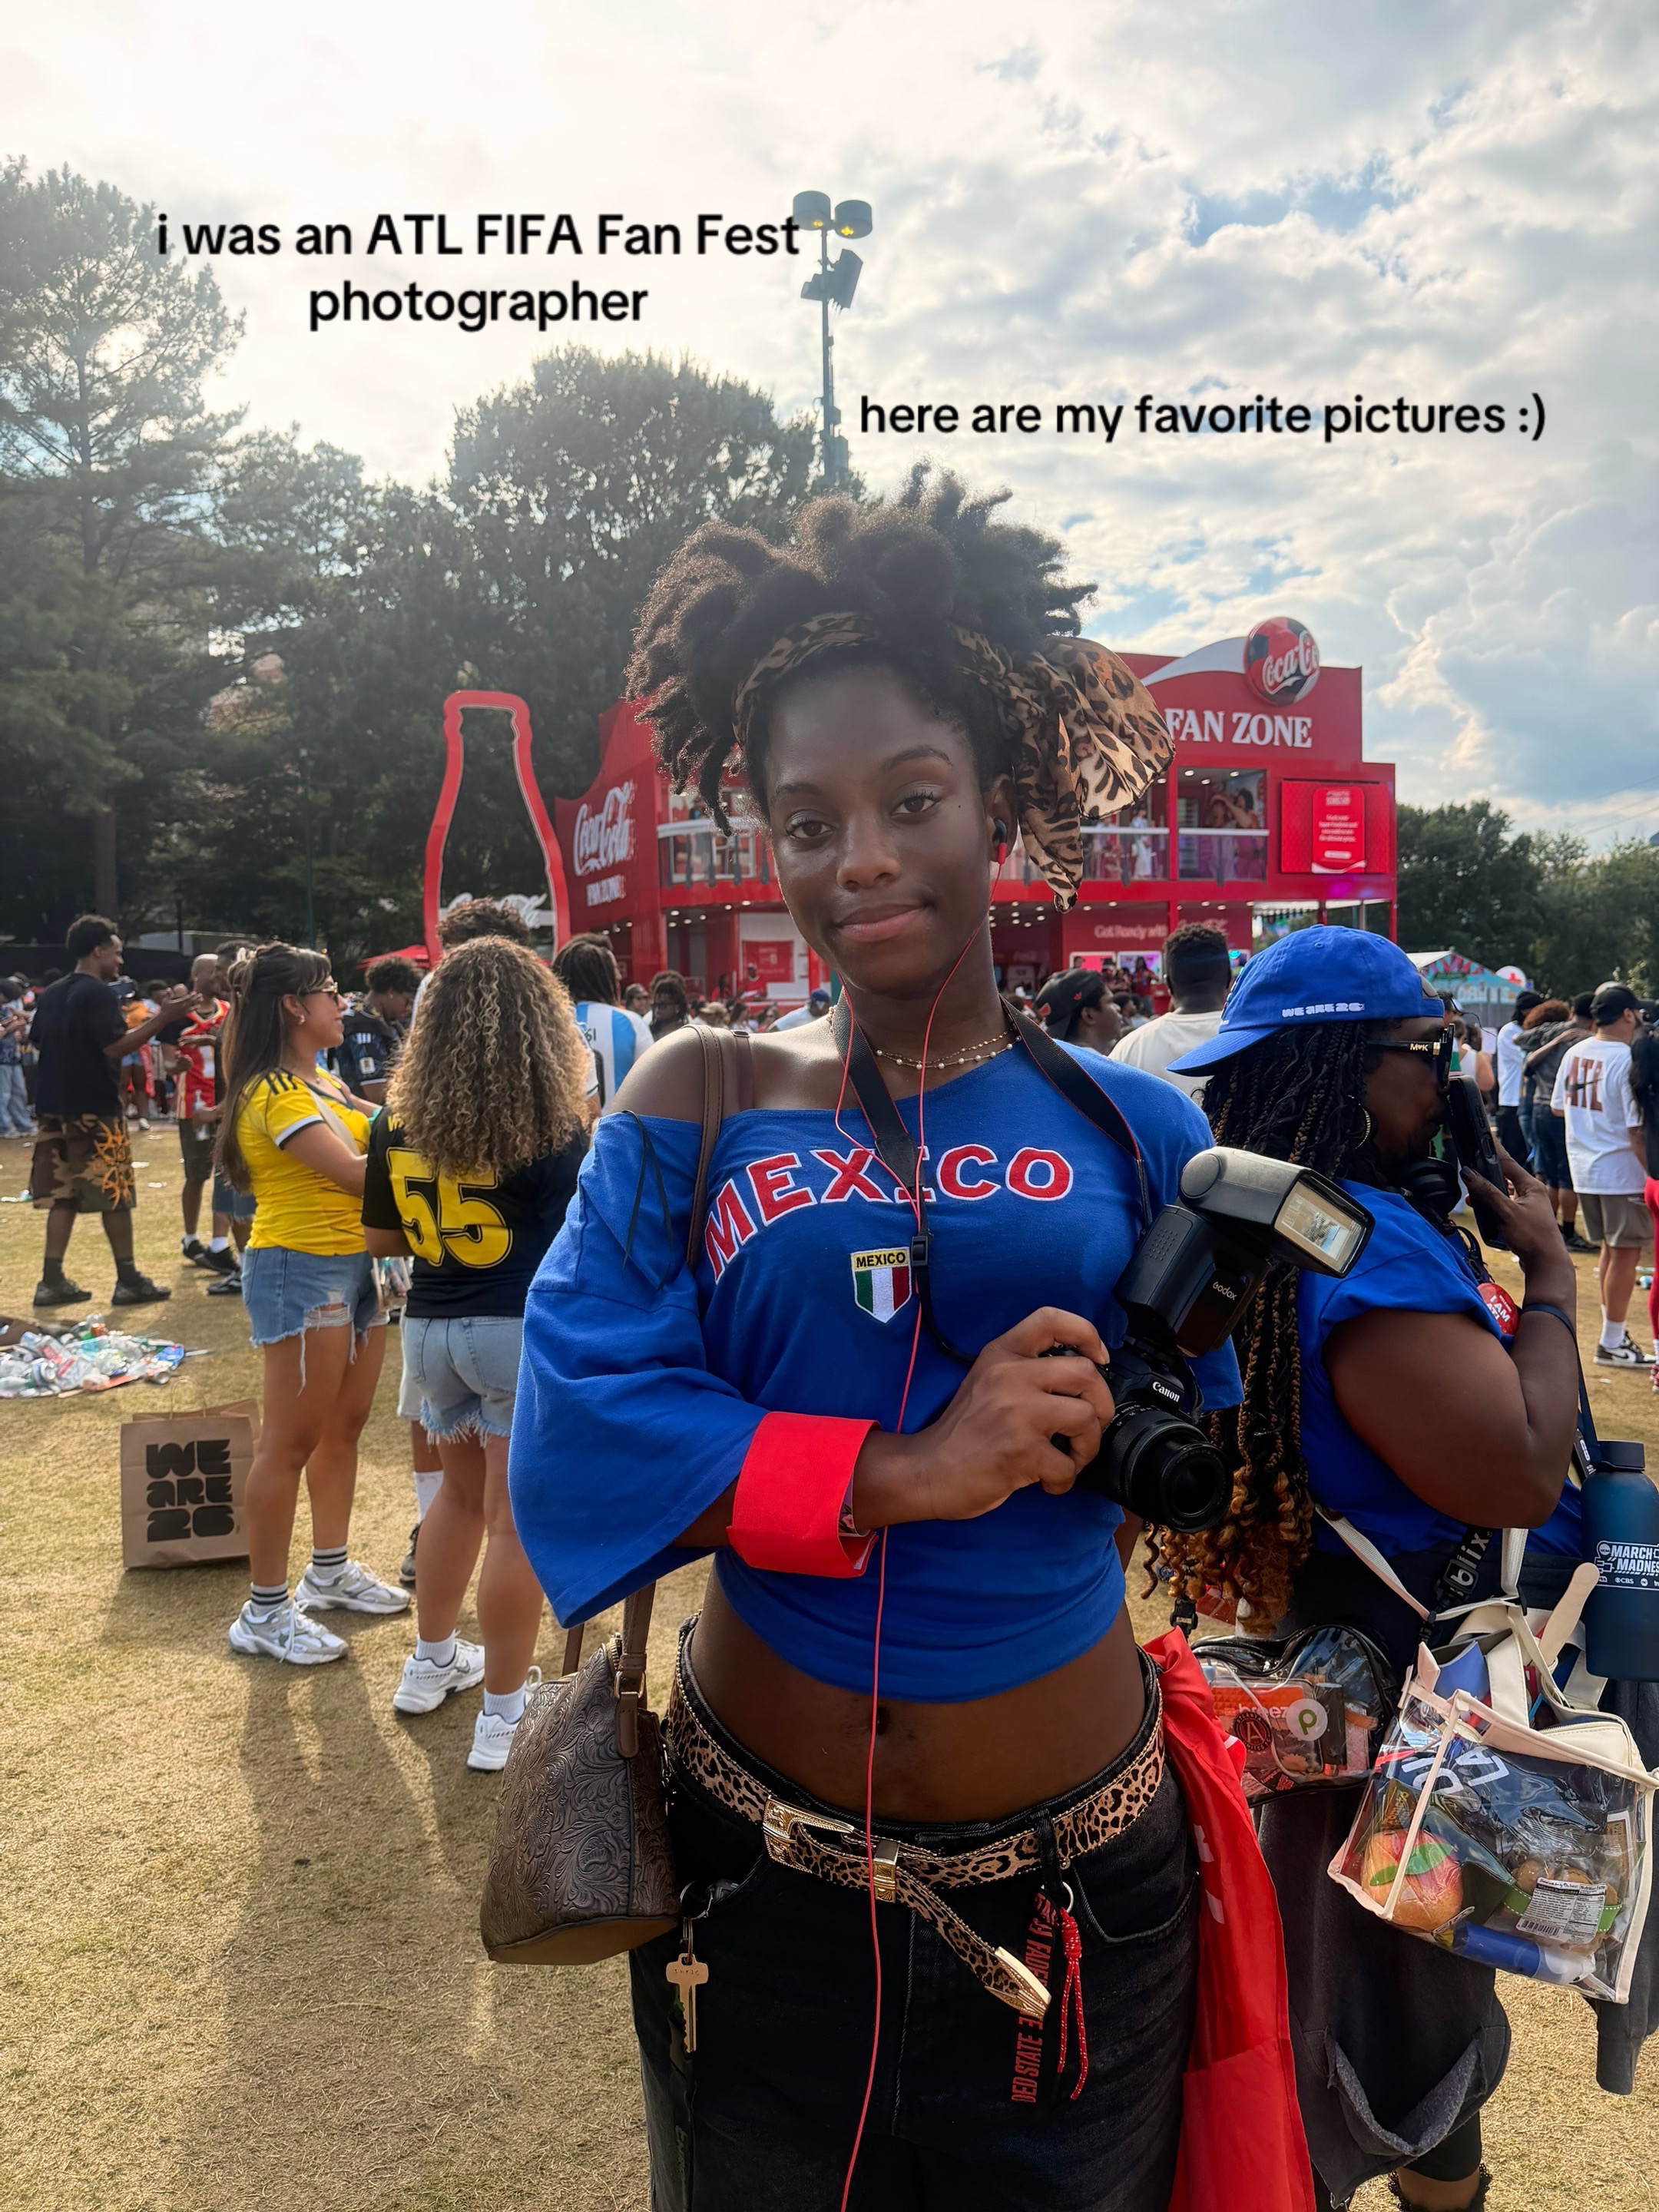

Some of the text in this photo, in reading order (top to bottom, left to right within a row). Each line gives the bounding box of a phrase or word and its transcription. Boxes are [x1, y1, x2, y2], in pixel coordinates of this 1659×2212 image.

[1164, 707, 1313, 749] FAN ZONE
[1281, 1007, 1305, 1018] WE
[1306, 1003, 1335, 1015] ARE
[386, 1146, 514, 1270] 55
[856, 1251, 906, 1268] MEXICO
[1489, 1294, 1511, 1323] I AM
[1152, 1381, 1181, 1402] Canon
[145, 1439, 232, 1479] WE
[146, 1475, 233, 1508] ARE
[147, 1505, 235, 1543] 26
[1610, 1545, 1654, 1560] MARCH
[1616, 1558, 1659, 1574] MADNES
[1236, 1711, 1263, 1725] ATLANTA
[1025, 1938, 1052, 1991] FADE
[1015, 2032, 1044, 2078] STATE
